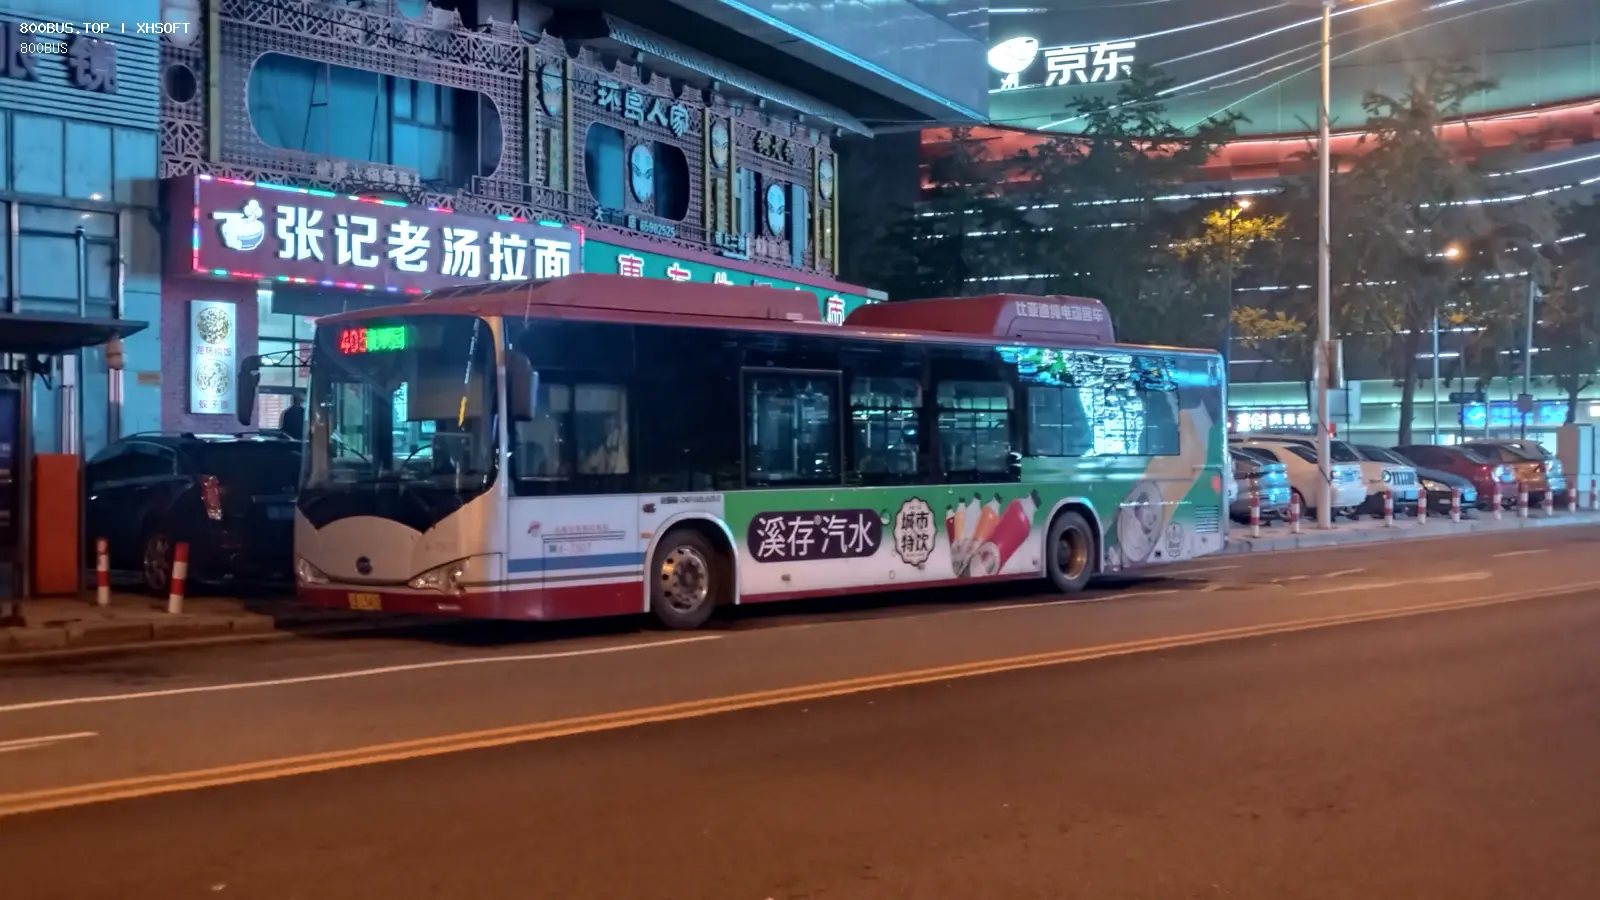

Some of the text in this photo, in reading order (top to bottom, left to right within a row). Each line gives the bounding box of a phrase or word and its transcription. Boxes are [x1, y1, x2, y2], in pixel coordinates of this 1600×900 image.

[1045, 42, 1136, 86] 京东
[276, 205, 572, 281] 张记老汤拉面
[1015, 301, 1104, 322] 比亚迪纯电动客车
[901, 511, 929, 530] 城市
[901, 533, 929, 552] 特饮
